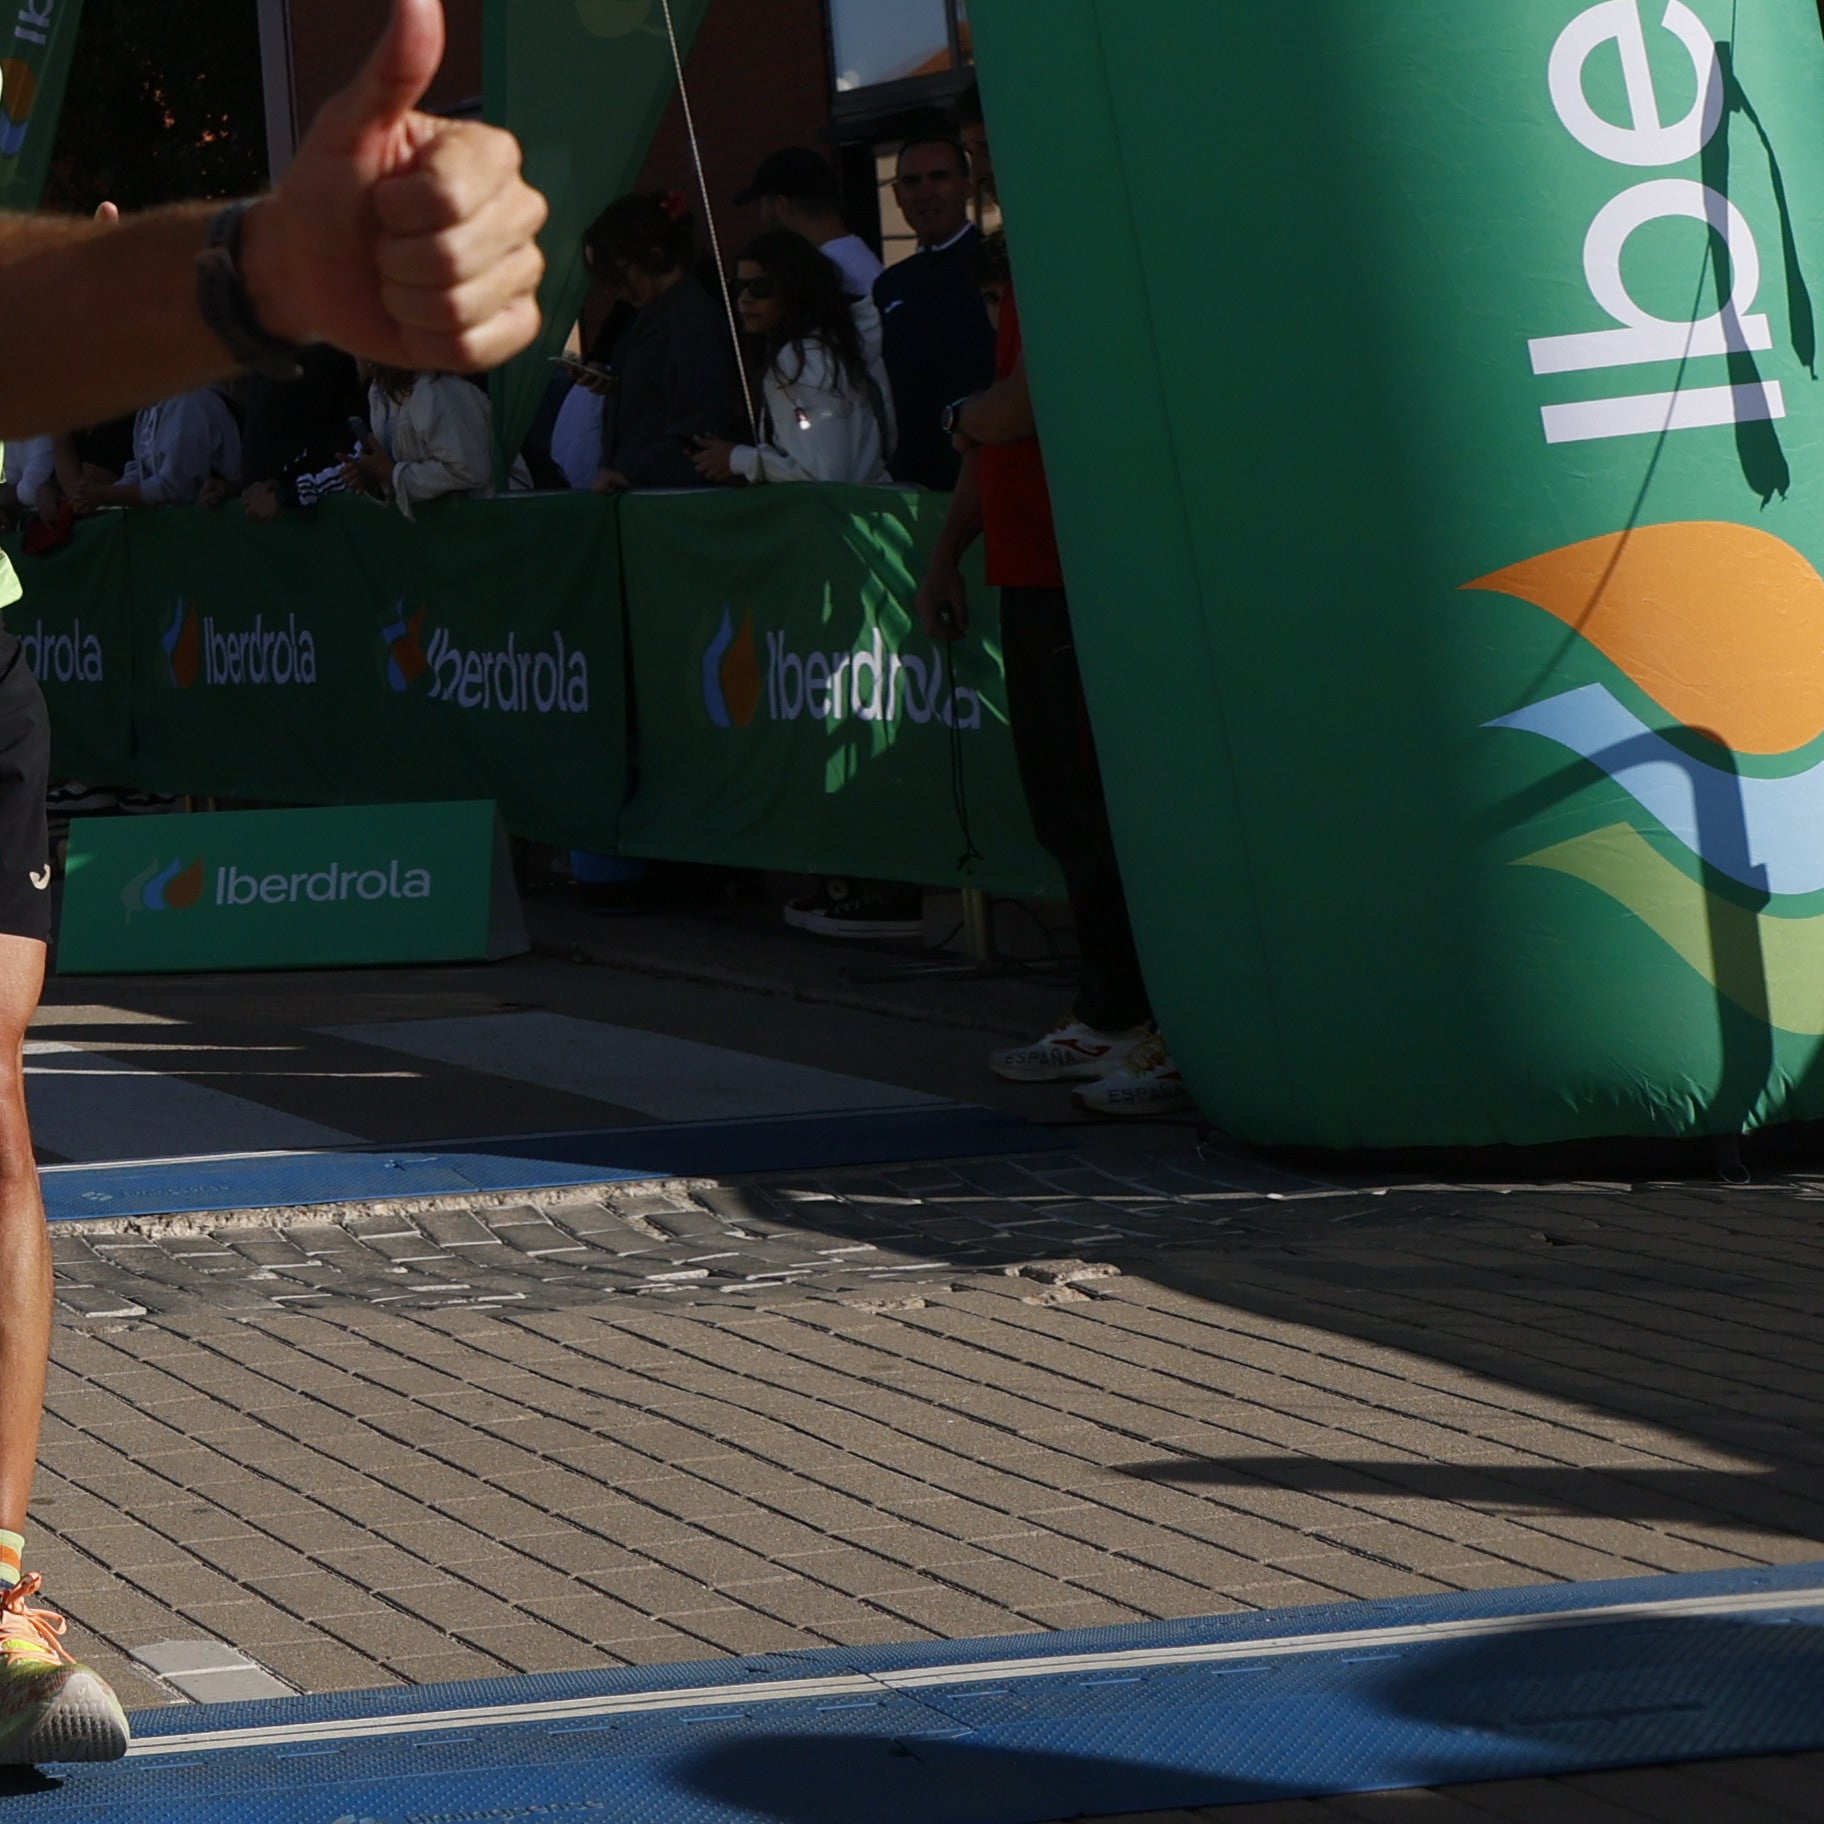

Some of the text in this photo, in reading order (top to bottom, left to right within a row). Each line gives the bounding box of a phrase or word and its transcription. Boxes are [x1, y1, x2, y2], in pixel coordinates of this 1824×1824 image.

[20, 618, 103, 682] drola
[203, 613, 317, 686] Iberdrola
[425, 627, 590, 713] Iberdrola
[766, 626, 983, 730] Iberdrola
[216, 860, 432, 906] Iberdrola
[1005, 1048, 1078, 1066] ESPAÑA
